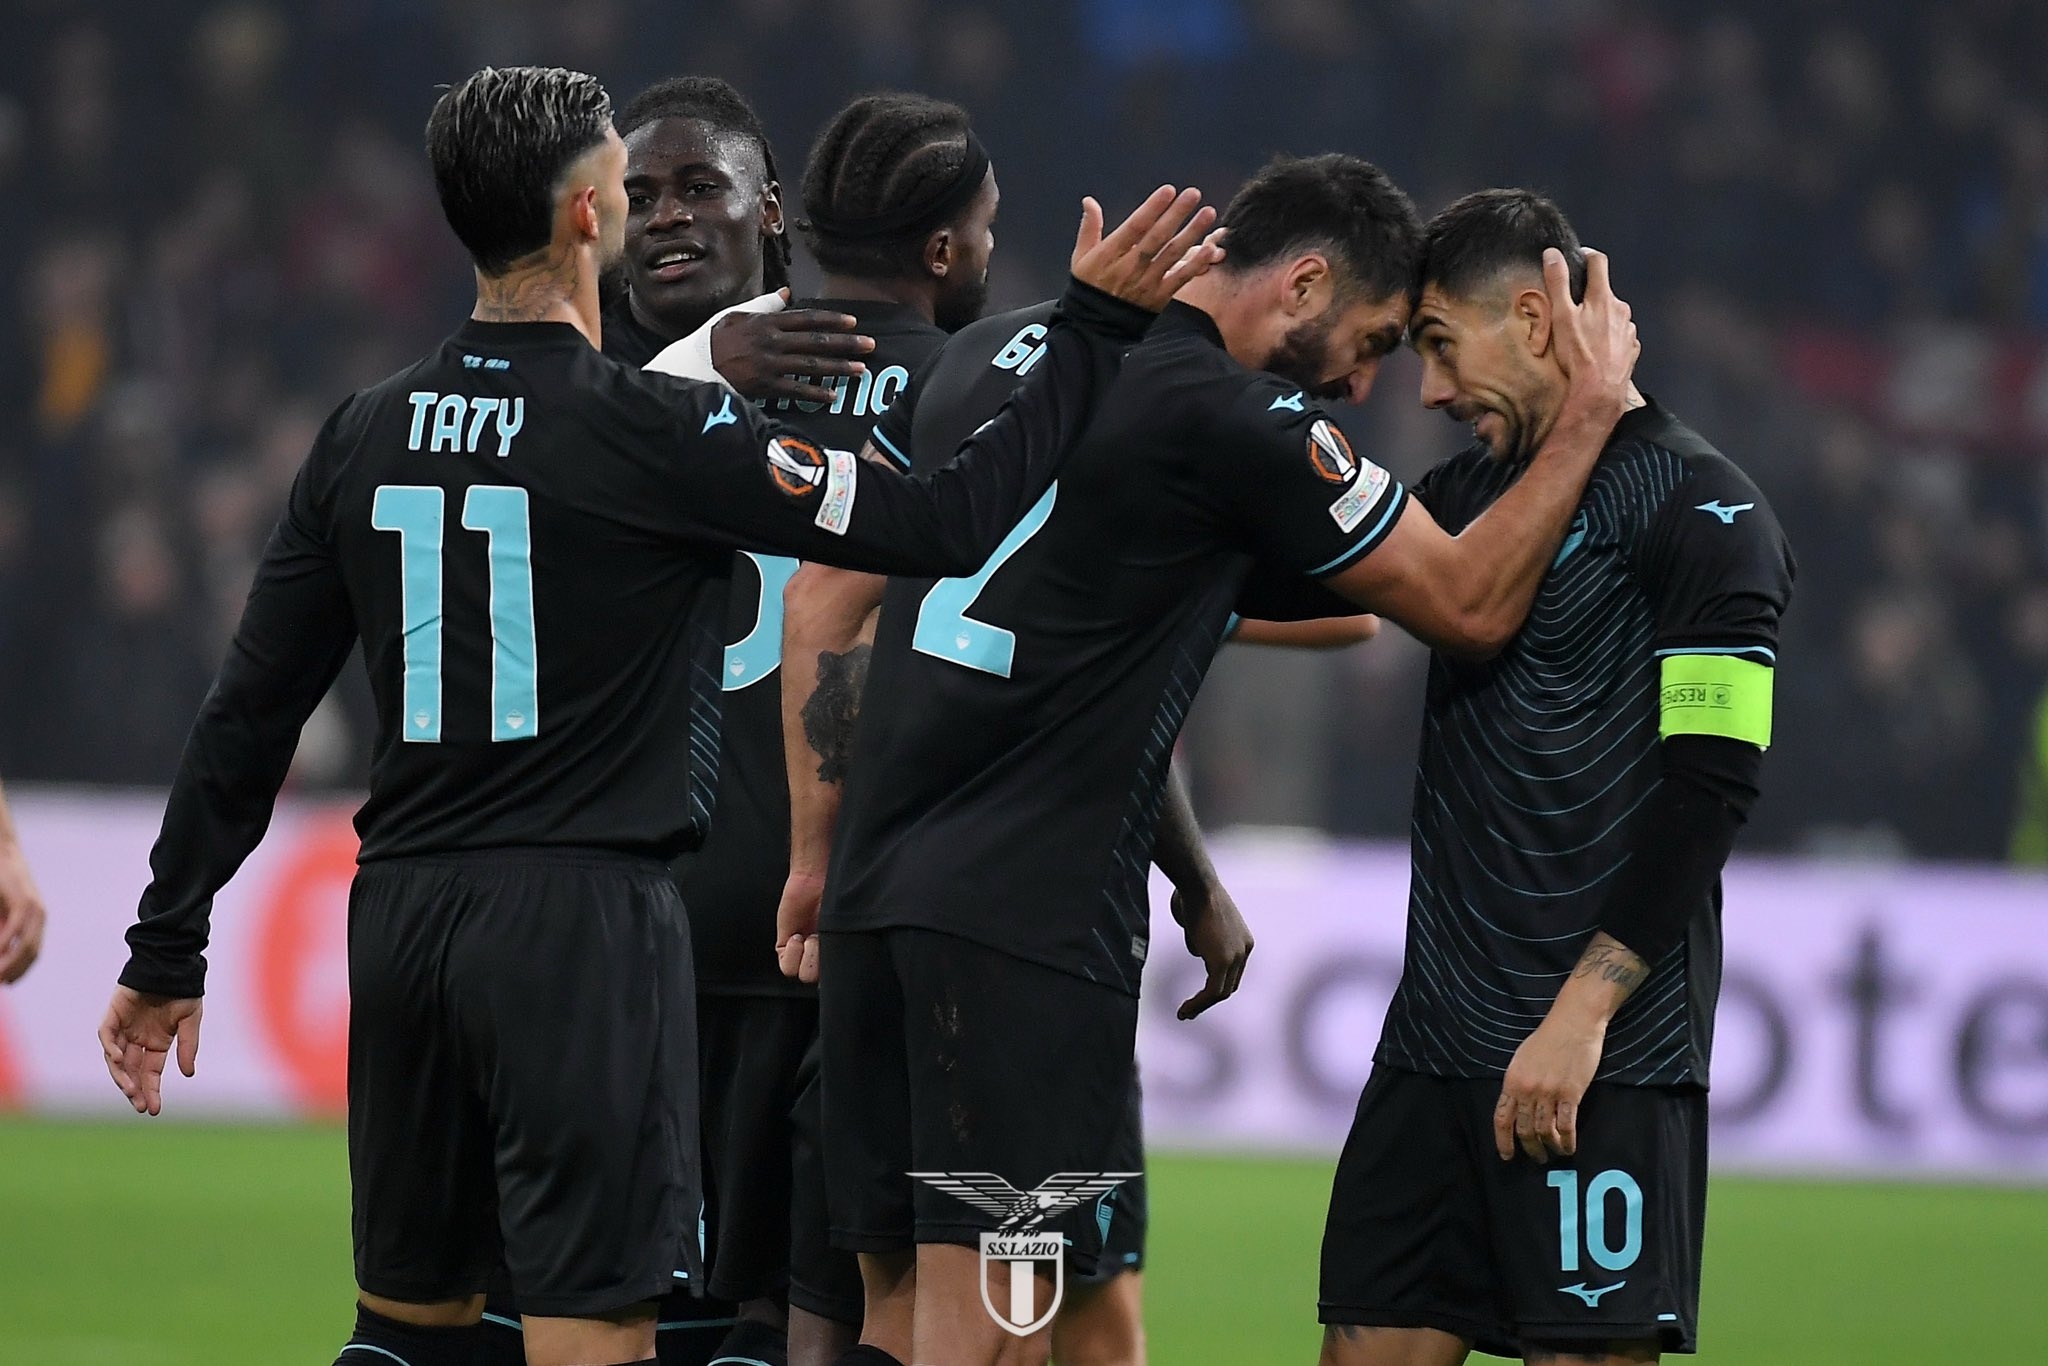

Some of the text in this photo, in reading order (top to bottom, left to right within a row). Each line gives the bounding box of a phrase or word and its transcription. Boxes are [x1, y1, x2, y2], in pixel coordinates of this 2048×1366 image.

[408, 392, 524, 457] TATY
[371, 485, 538, 742] 11
[1547, 1169, 1643, 1271] 10
